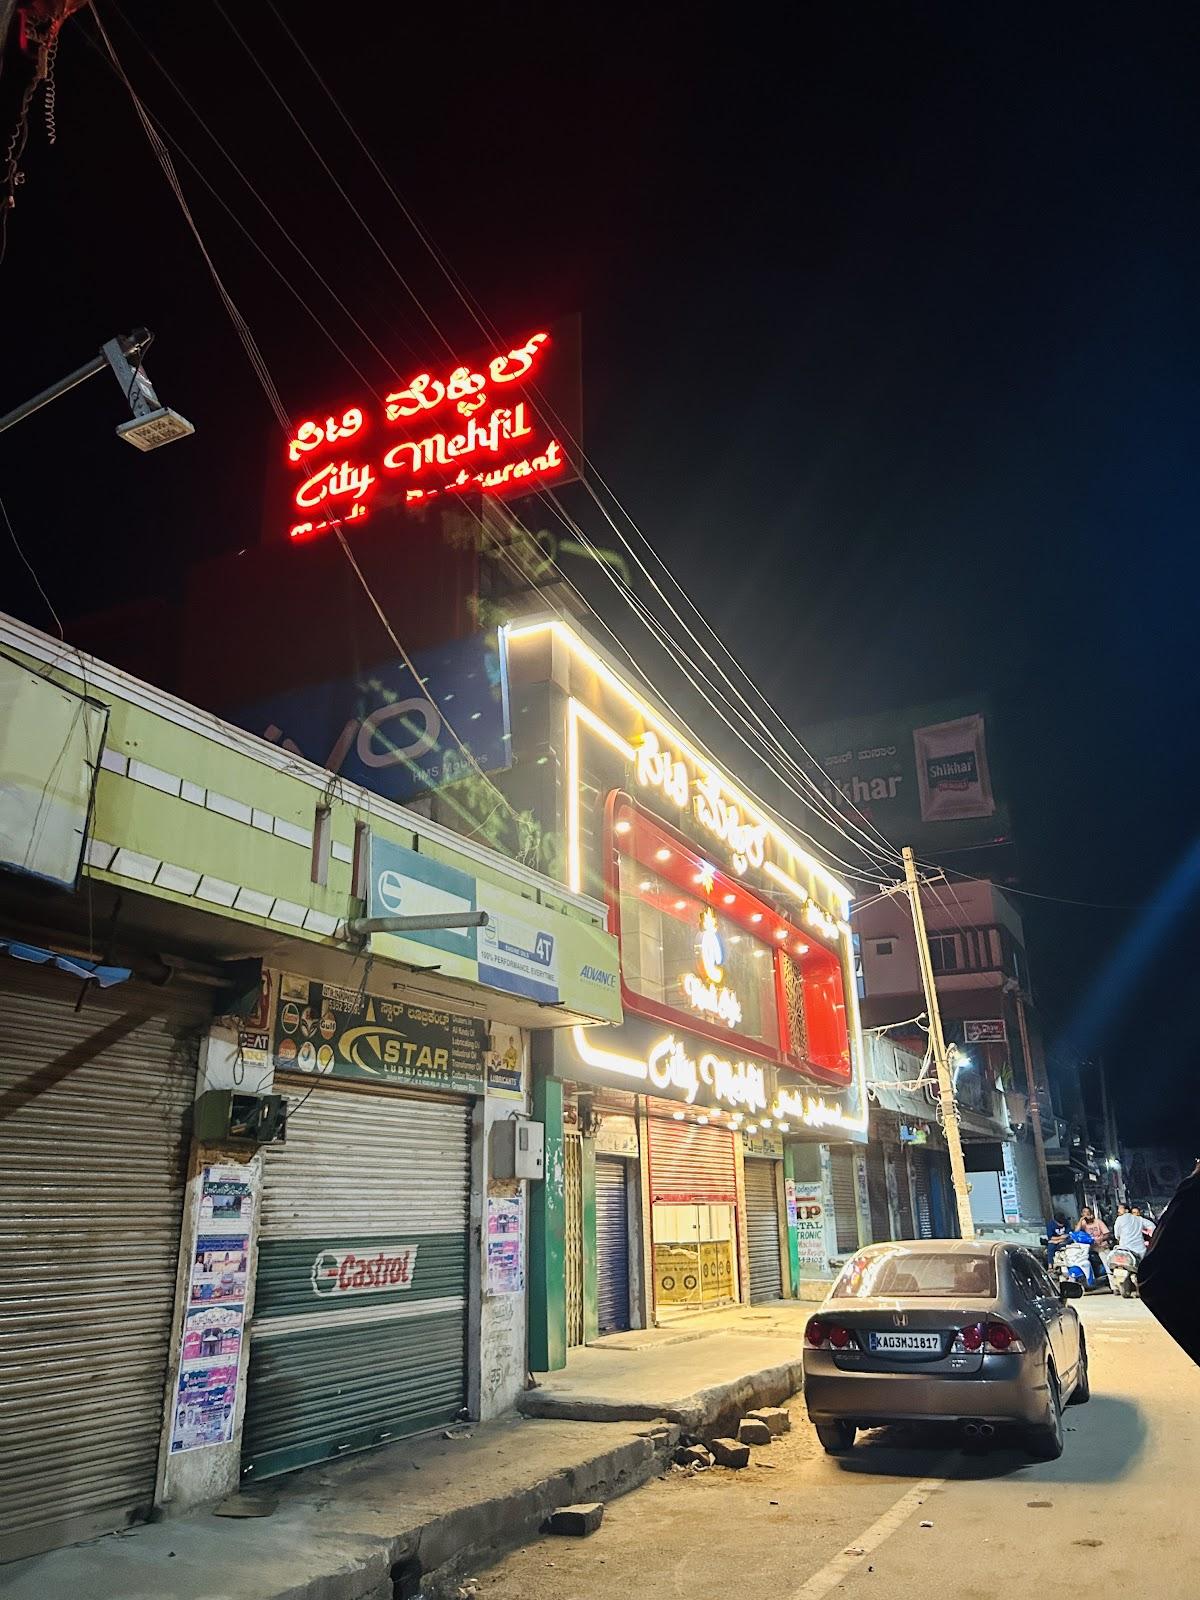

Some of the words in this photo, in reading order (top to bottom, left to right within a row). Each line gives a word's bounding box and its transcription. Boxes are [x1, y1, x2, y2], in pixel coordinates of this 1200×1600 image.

[289, 408, 363, 461] ಸಿಟಿ
[296, 461, 375, 507] City
[383, 402, 531, 472] Mehfil
[930, 759, 973, 778] Shikhar
[536, 938, 551, 961] 4T
[581, 965, 617, 987] ADVANCE
[320, 1020, 336, 1030] Gulf
[240, 1033, 268, 1048] CEAT
[384, 1039, 449, 1071] STAR
[384, 1063, 449, 1080] LUBRICANTS
[649, 1034, 698, 1104] City
[338, 1250, 411, 1291] Castrol
